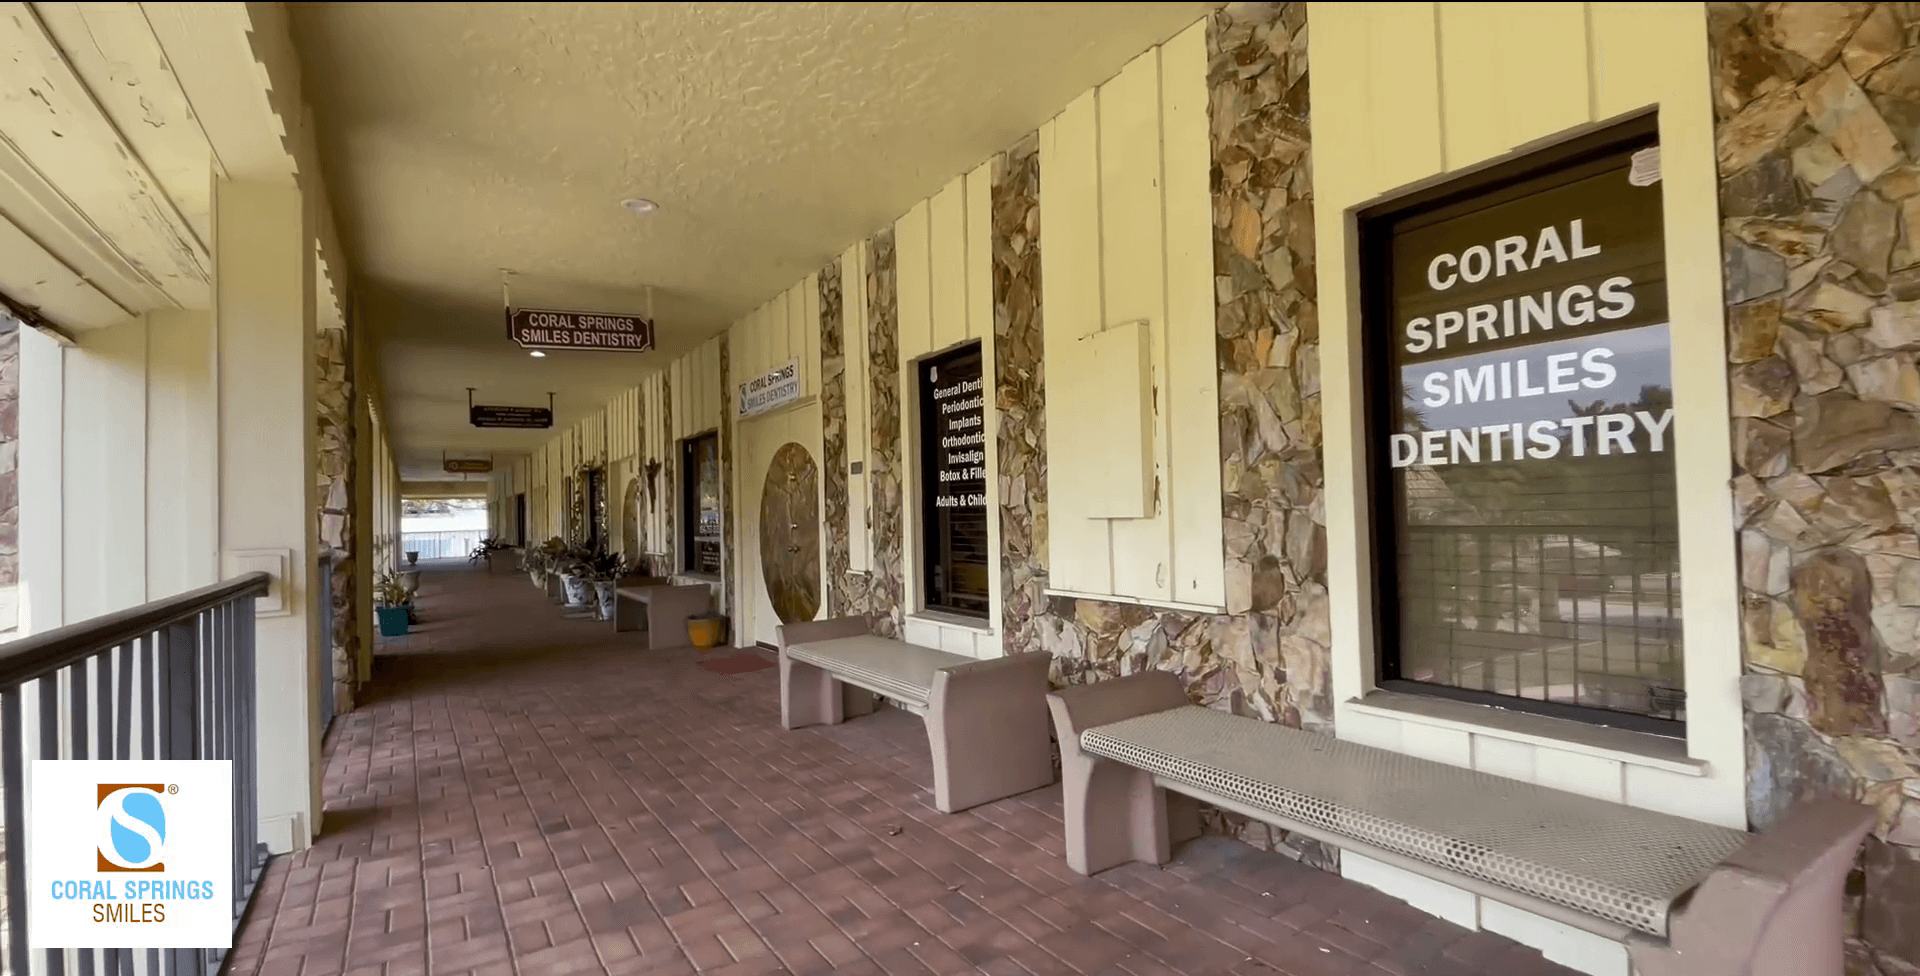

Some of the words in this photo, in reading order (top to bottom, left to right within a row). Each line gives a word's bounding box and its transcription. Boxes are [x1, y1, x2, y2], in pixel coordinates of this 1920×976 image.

[1427, 218, 1602, 291] CORAL
[528, 313, 576, 329] CORAL
[578, 316, 634, 332] SPRINGS
[1405, 276, 1636, 354] SPRINGS
[521, 328, 570, 344] SMILES
[573, 331, 643, 347] DENTISTRY
[750, 376, 767, 393] CORAL
[768, 364, 794, 386] SPRINGS
[1422, 347, 1617, 408] SMILES
[766, 381, 798, 403] DENTISTRY
[933, 383, 961, 400] General
[962, 376, 983, 393] Denti
[942, 395, 984, 415] Periodontic
[949, 414, 982, 431] Implants
[942, 431, 986, 448] Orthodontic
[1390, 408, 1675, 468] DENTISTRY
[948, 449, 984, 465] Invisalign
[940, 470, 961, 482] Botox
[962, 468, 969, 480] &
[936, 495, 959, 507] Adults
[959, 494, 967, 506] &
